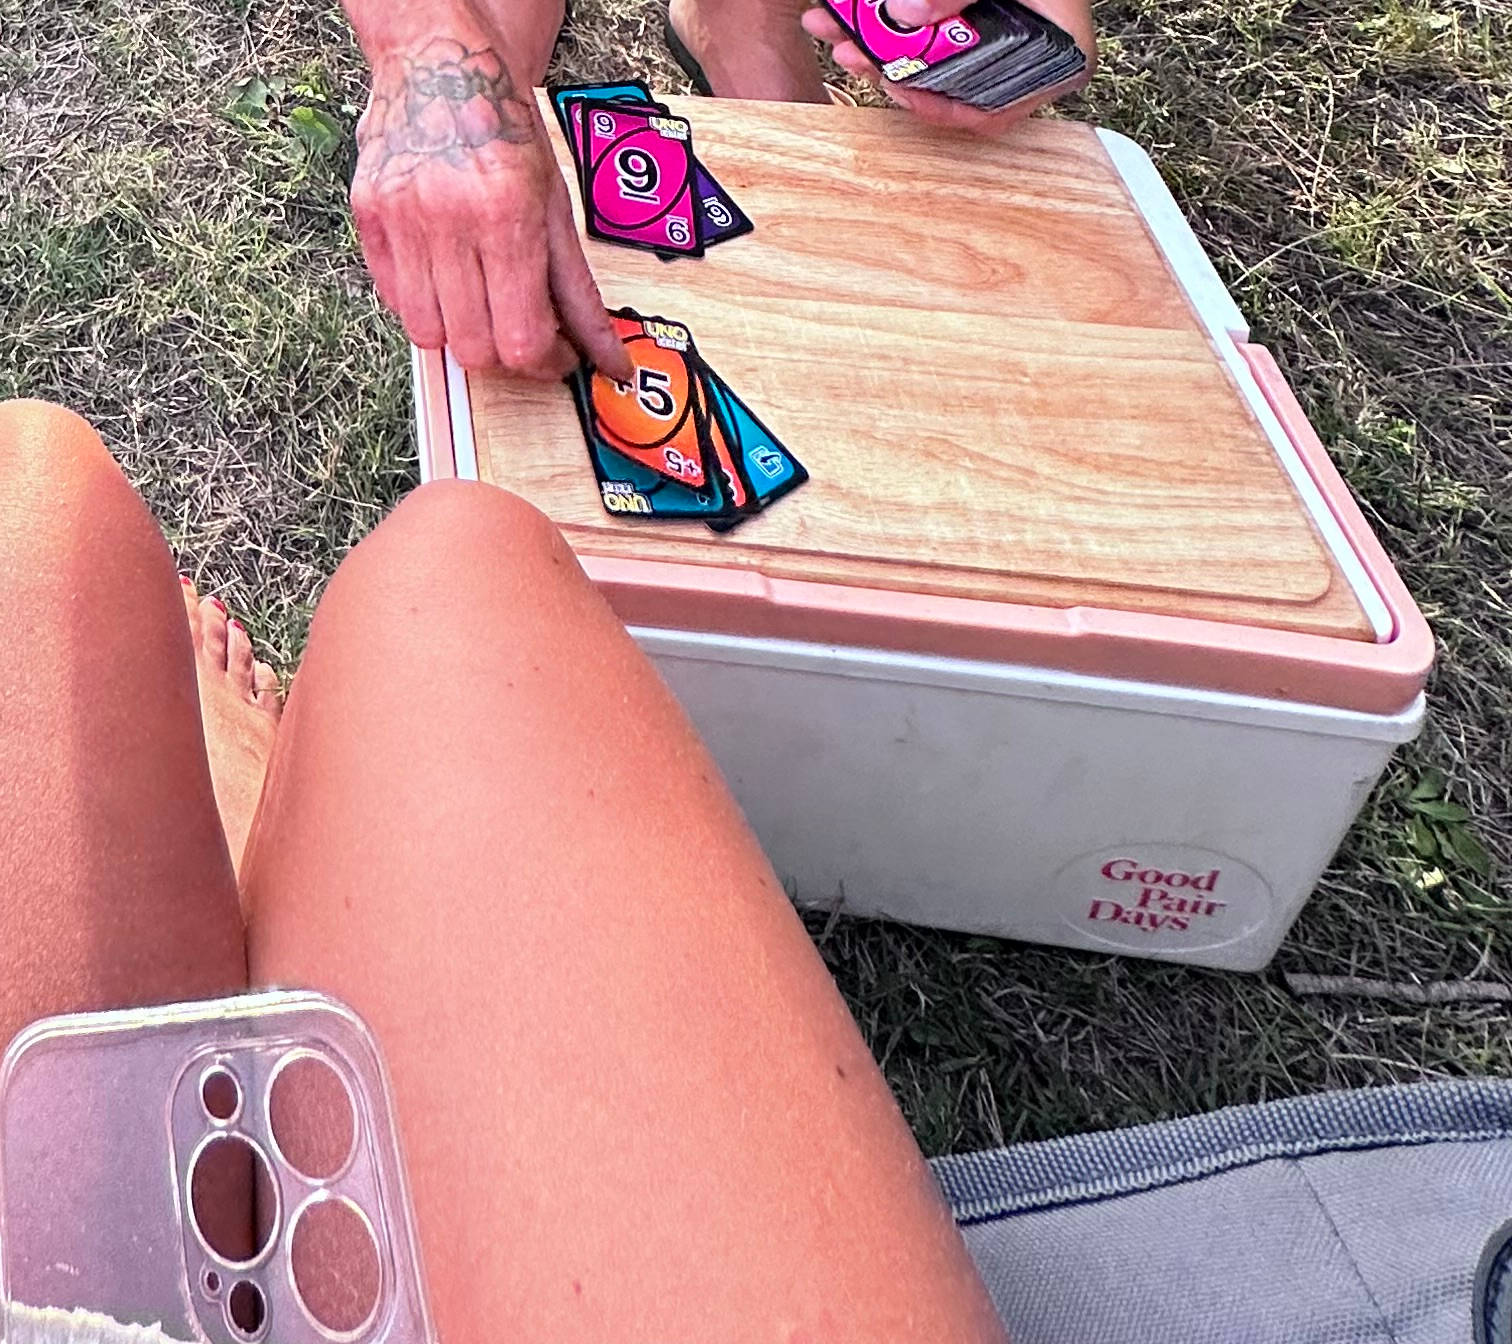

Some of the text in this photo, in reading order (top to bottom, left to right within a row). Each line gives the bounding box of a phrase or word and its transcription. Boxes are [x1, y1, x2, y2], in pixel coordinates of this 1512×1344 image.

[594, 112, 616, 140] 9
[649, 116, 689, 132] UNO
[614, 147, 661, 205] 9
[643, 320, 688, 343] UNO
[603, 492, 653, 514] UNO
[1100, 858, 1221, 892] Good
[1087, 899, 1190, 932] Days
[1138, 887, 1227, 916] Pair
